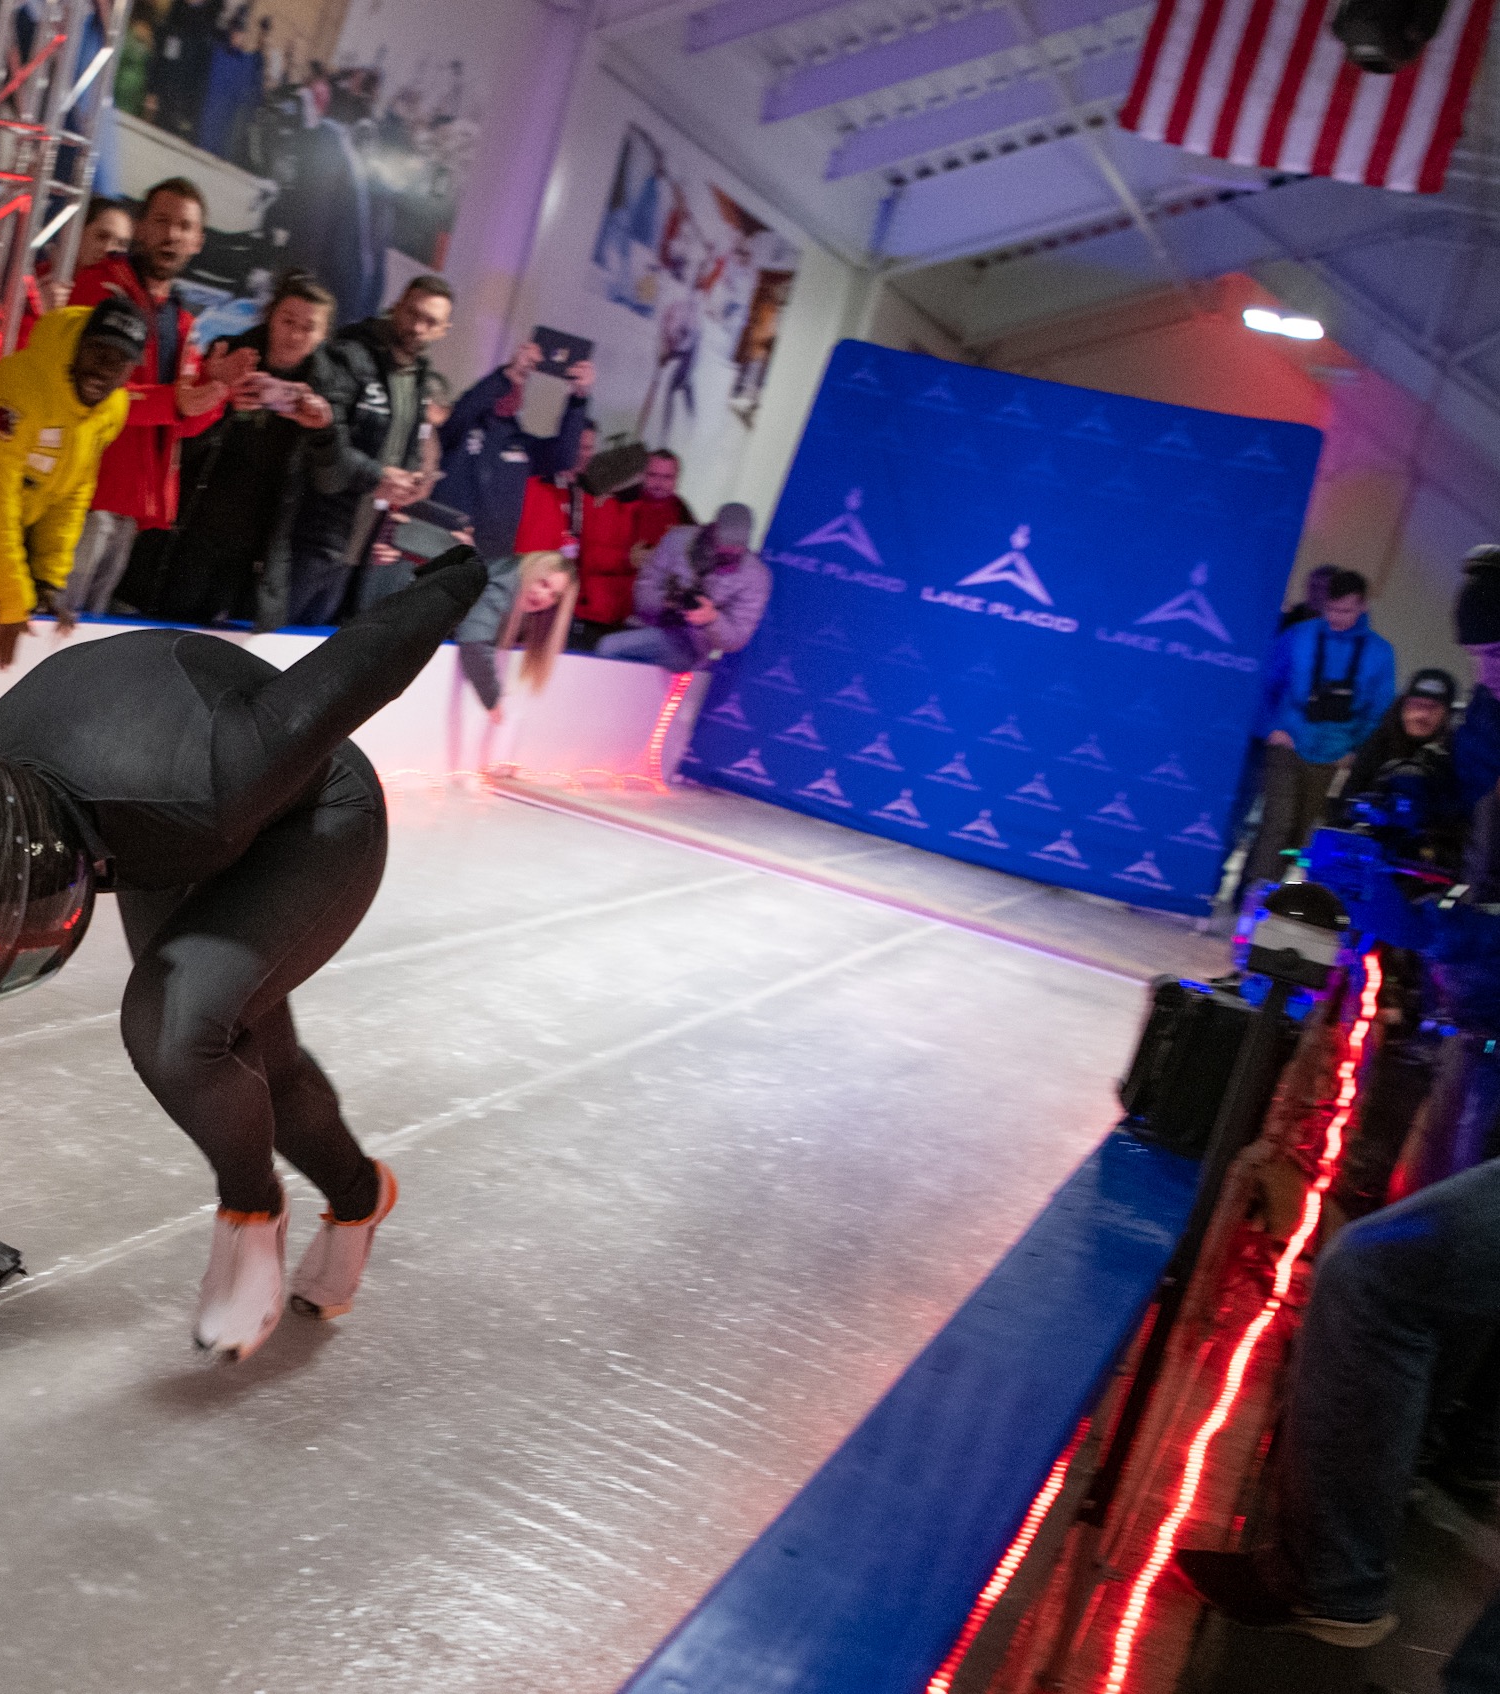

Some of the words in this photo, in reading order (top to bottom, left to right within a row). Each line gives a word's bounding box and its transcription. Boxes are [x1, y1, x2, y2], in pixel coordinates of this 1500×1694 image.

[920, 586, 986, 612] LAKE
[986, 602, 1079, 633] PLACID
[1095, 627, 1161, 651] LAKE
[1164, 641, 1258, 672] PLACID
